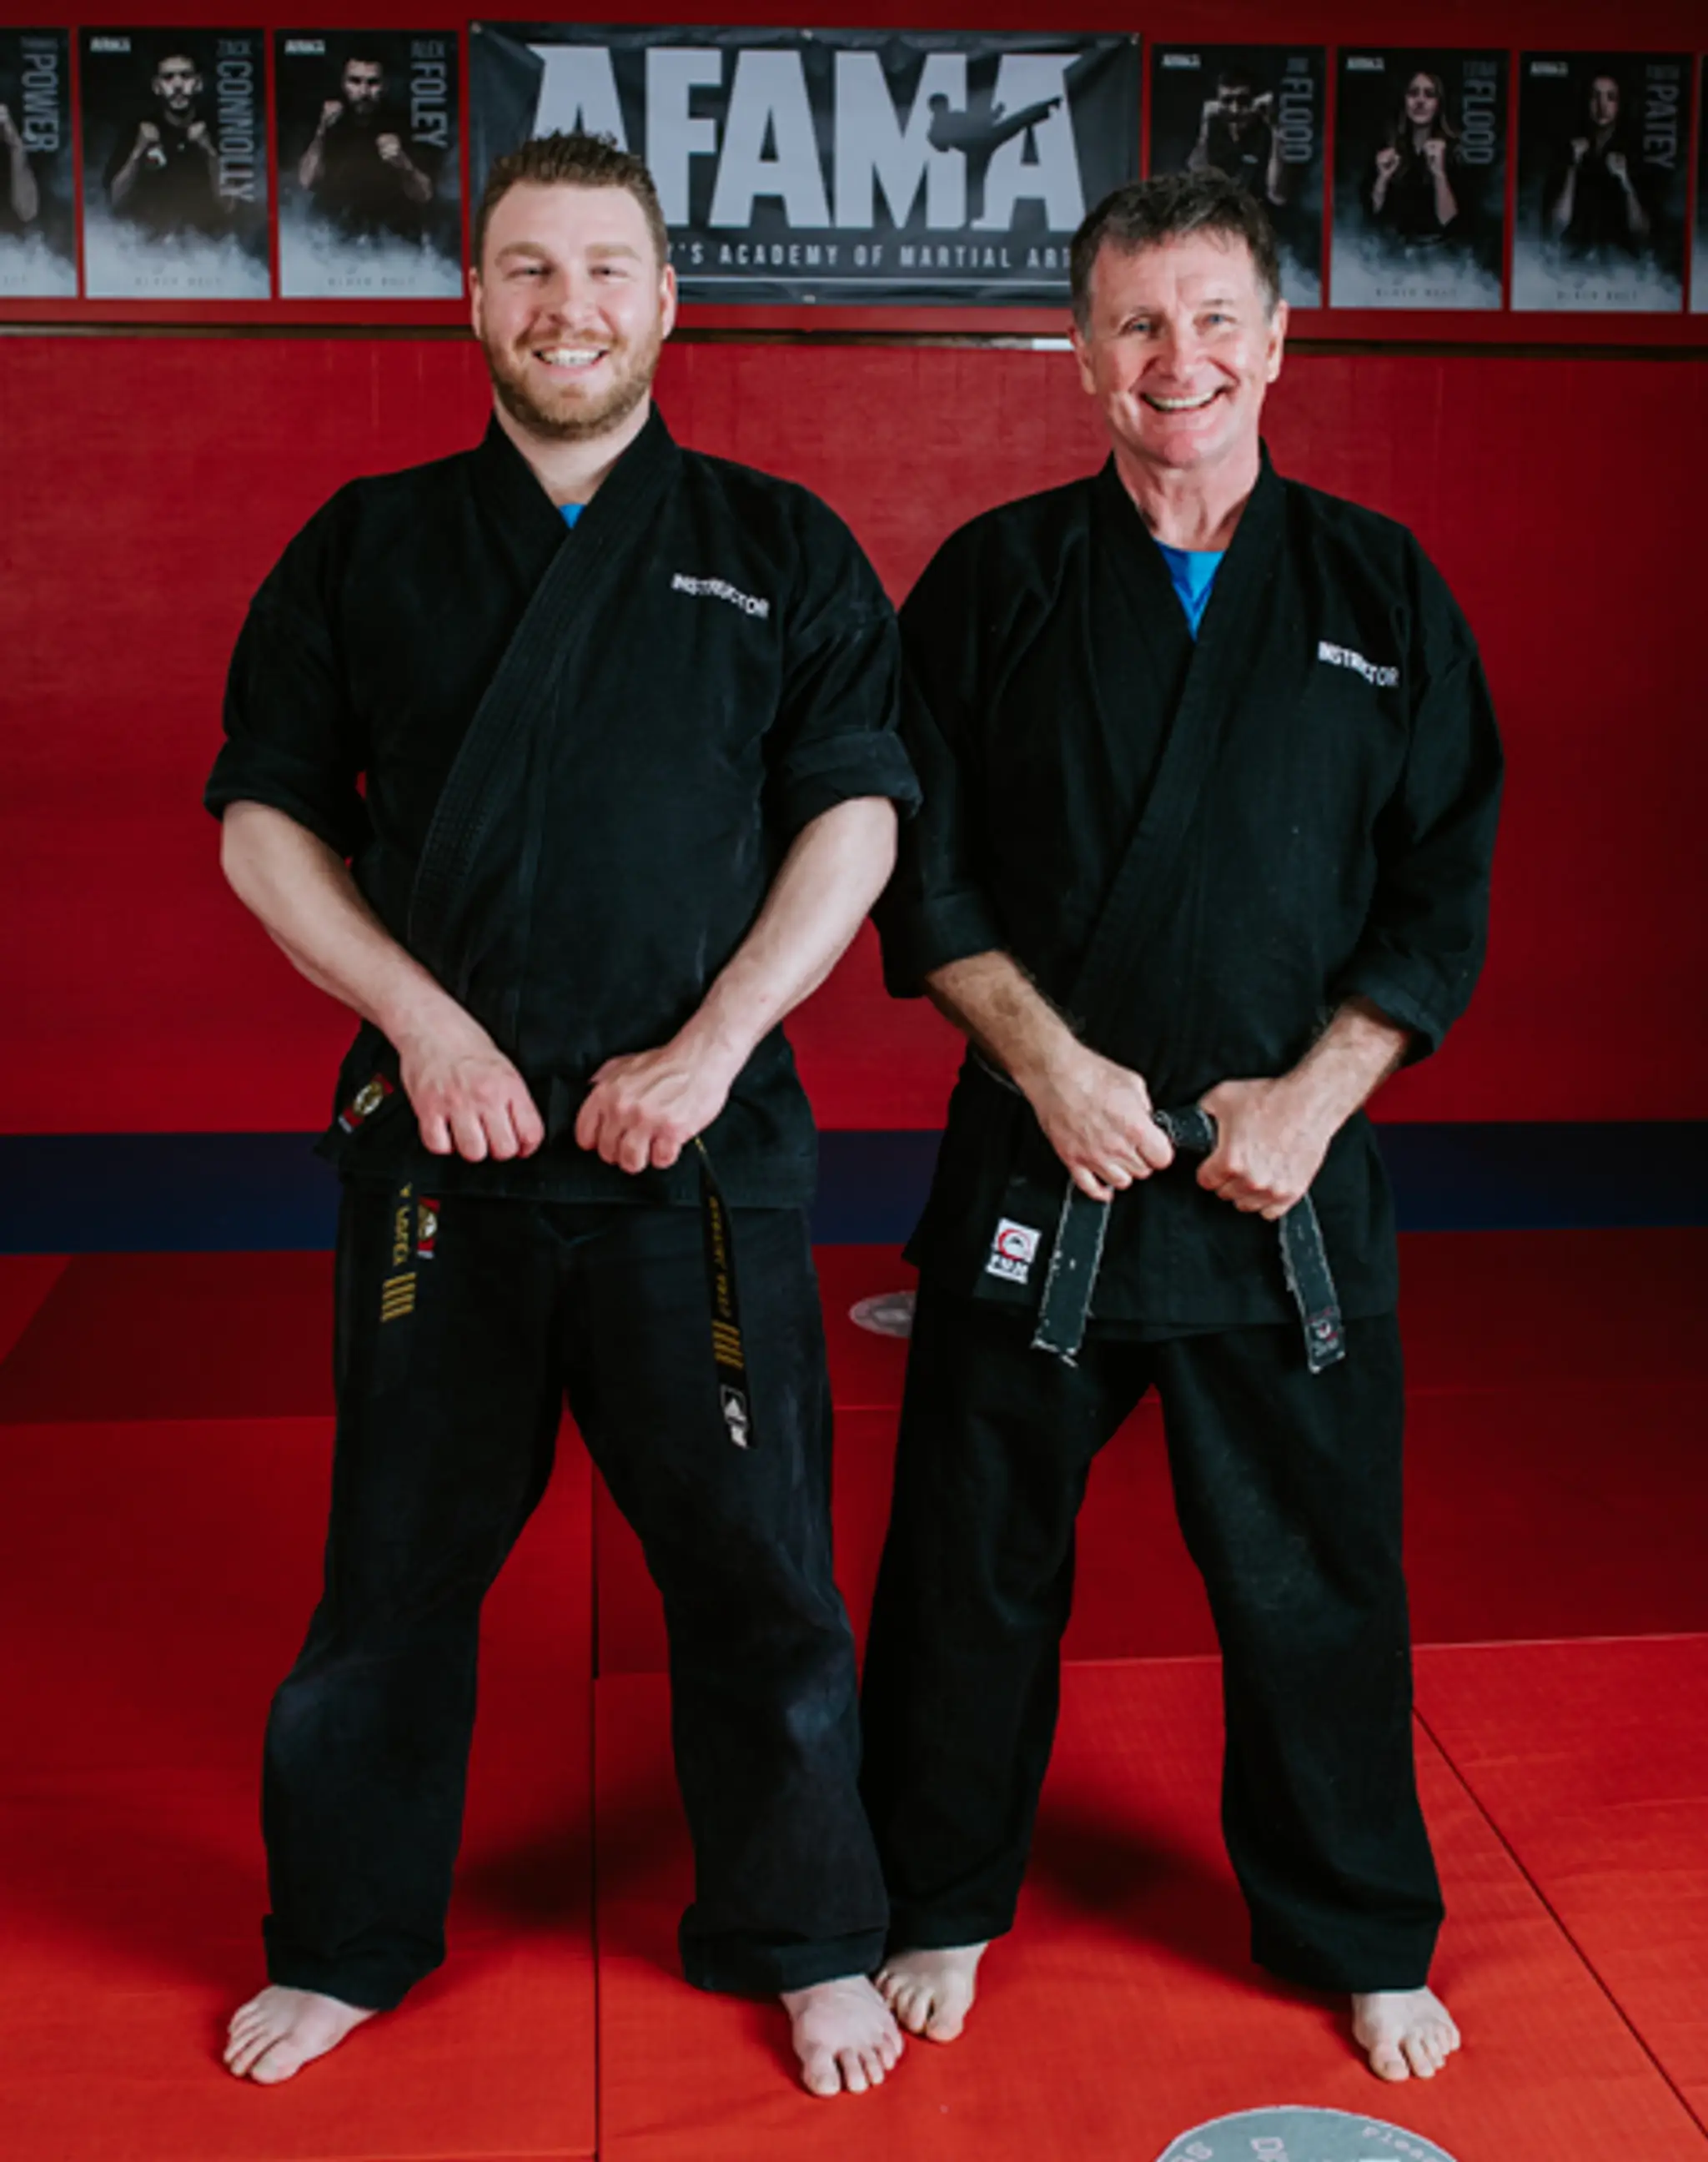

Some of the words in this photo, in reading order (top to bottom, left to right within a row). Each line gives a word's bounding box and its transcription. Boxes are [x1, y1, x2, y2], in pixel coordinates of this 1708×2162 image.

[22, 53, 59, 152] POWER
[216, 60, 255, 202] CONNOLLY
[409, 61, 448, 148] FOLEY
[527, 44, 1086, 230] AFAMA
[1279, 78, 1314, 164] FLOOD
[1462, 81, 1496, 167] FLOOD
[1646, 84, 1680, 169] PATEY
[718, 243, 836, 266] ACADEMY
[854, 245, 884, 266] OF
[900, 246, 1012, 269] MARTIAL
